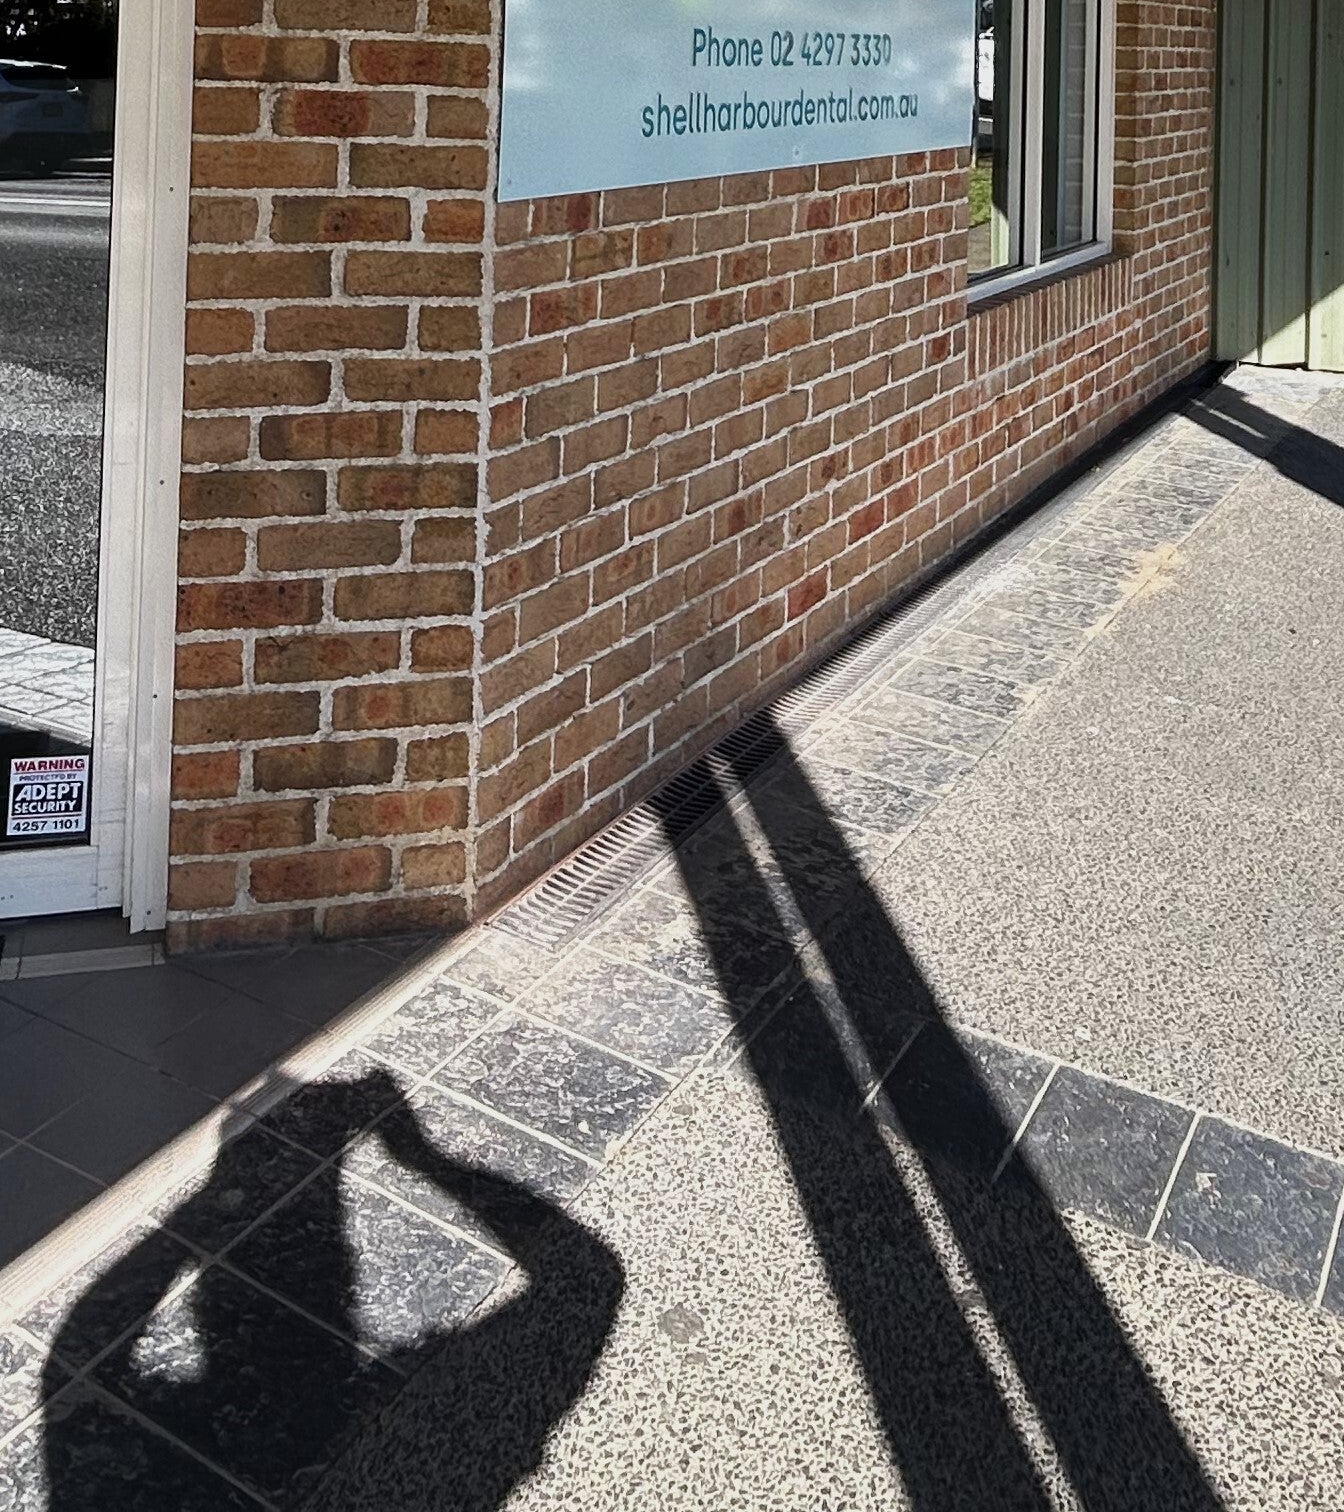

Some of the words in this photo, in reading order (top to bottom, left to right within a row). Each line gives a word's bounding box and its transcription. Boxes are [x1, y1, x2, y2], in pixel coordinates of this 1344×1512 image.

[692, 27, 763, 67] Phone
[770, 30, 794, 66] 02
[801, 32, 846, 66] 4297
[851, 33, 891, 66] 3330
[642, 89, 918, 138] shellharbourdental.com.au
[15, 759, 84, 771] WARNING
[15, 783, 81, 801] ADEPT
[14, 800, 76, 813] SECURITY
[13, 821, 48, 832] 4257
[53, 819, 80, 830] 1101
